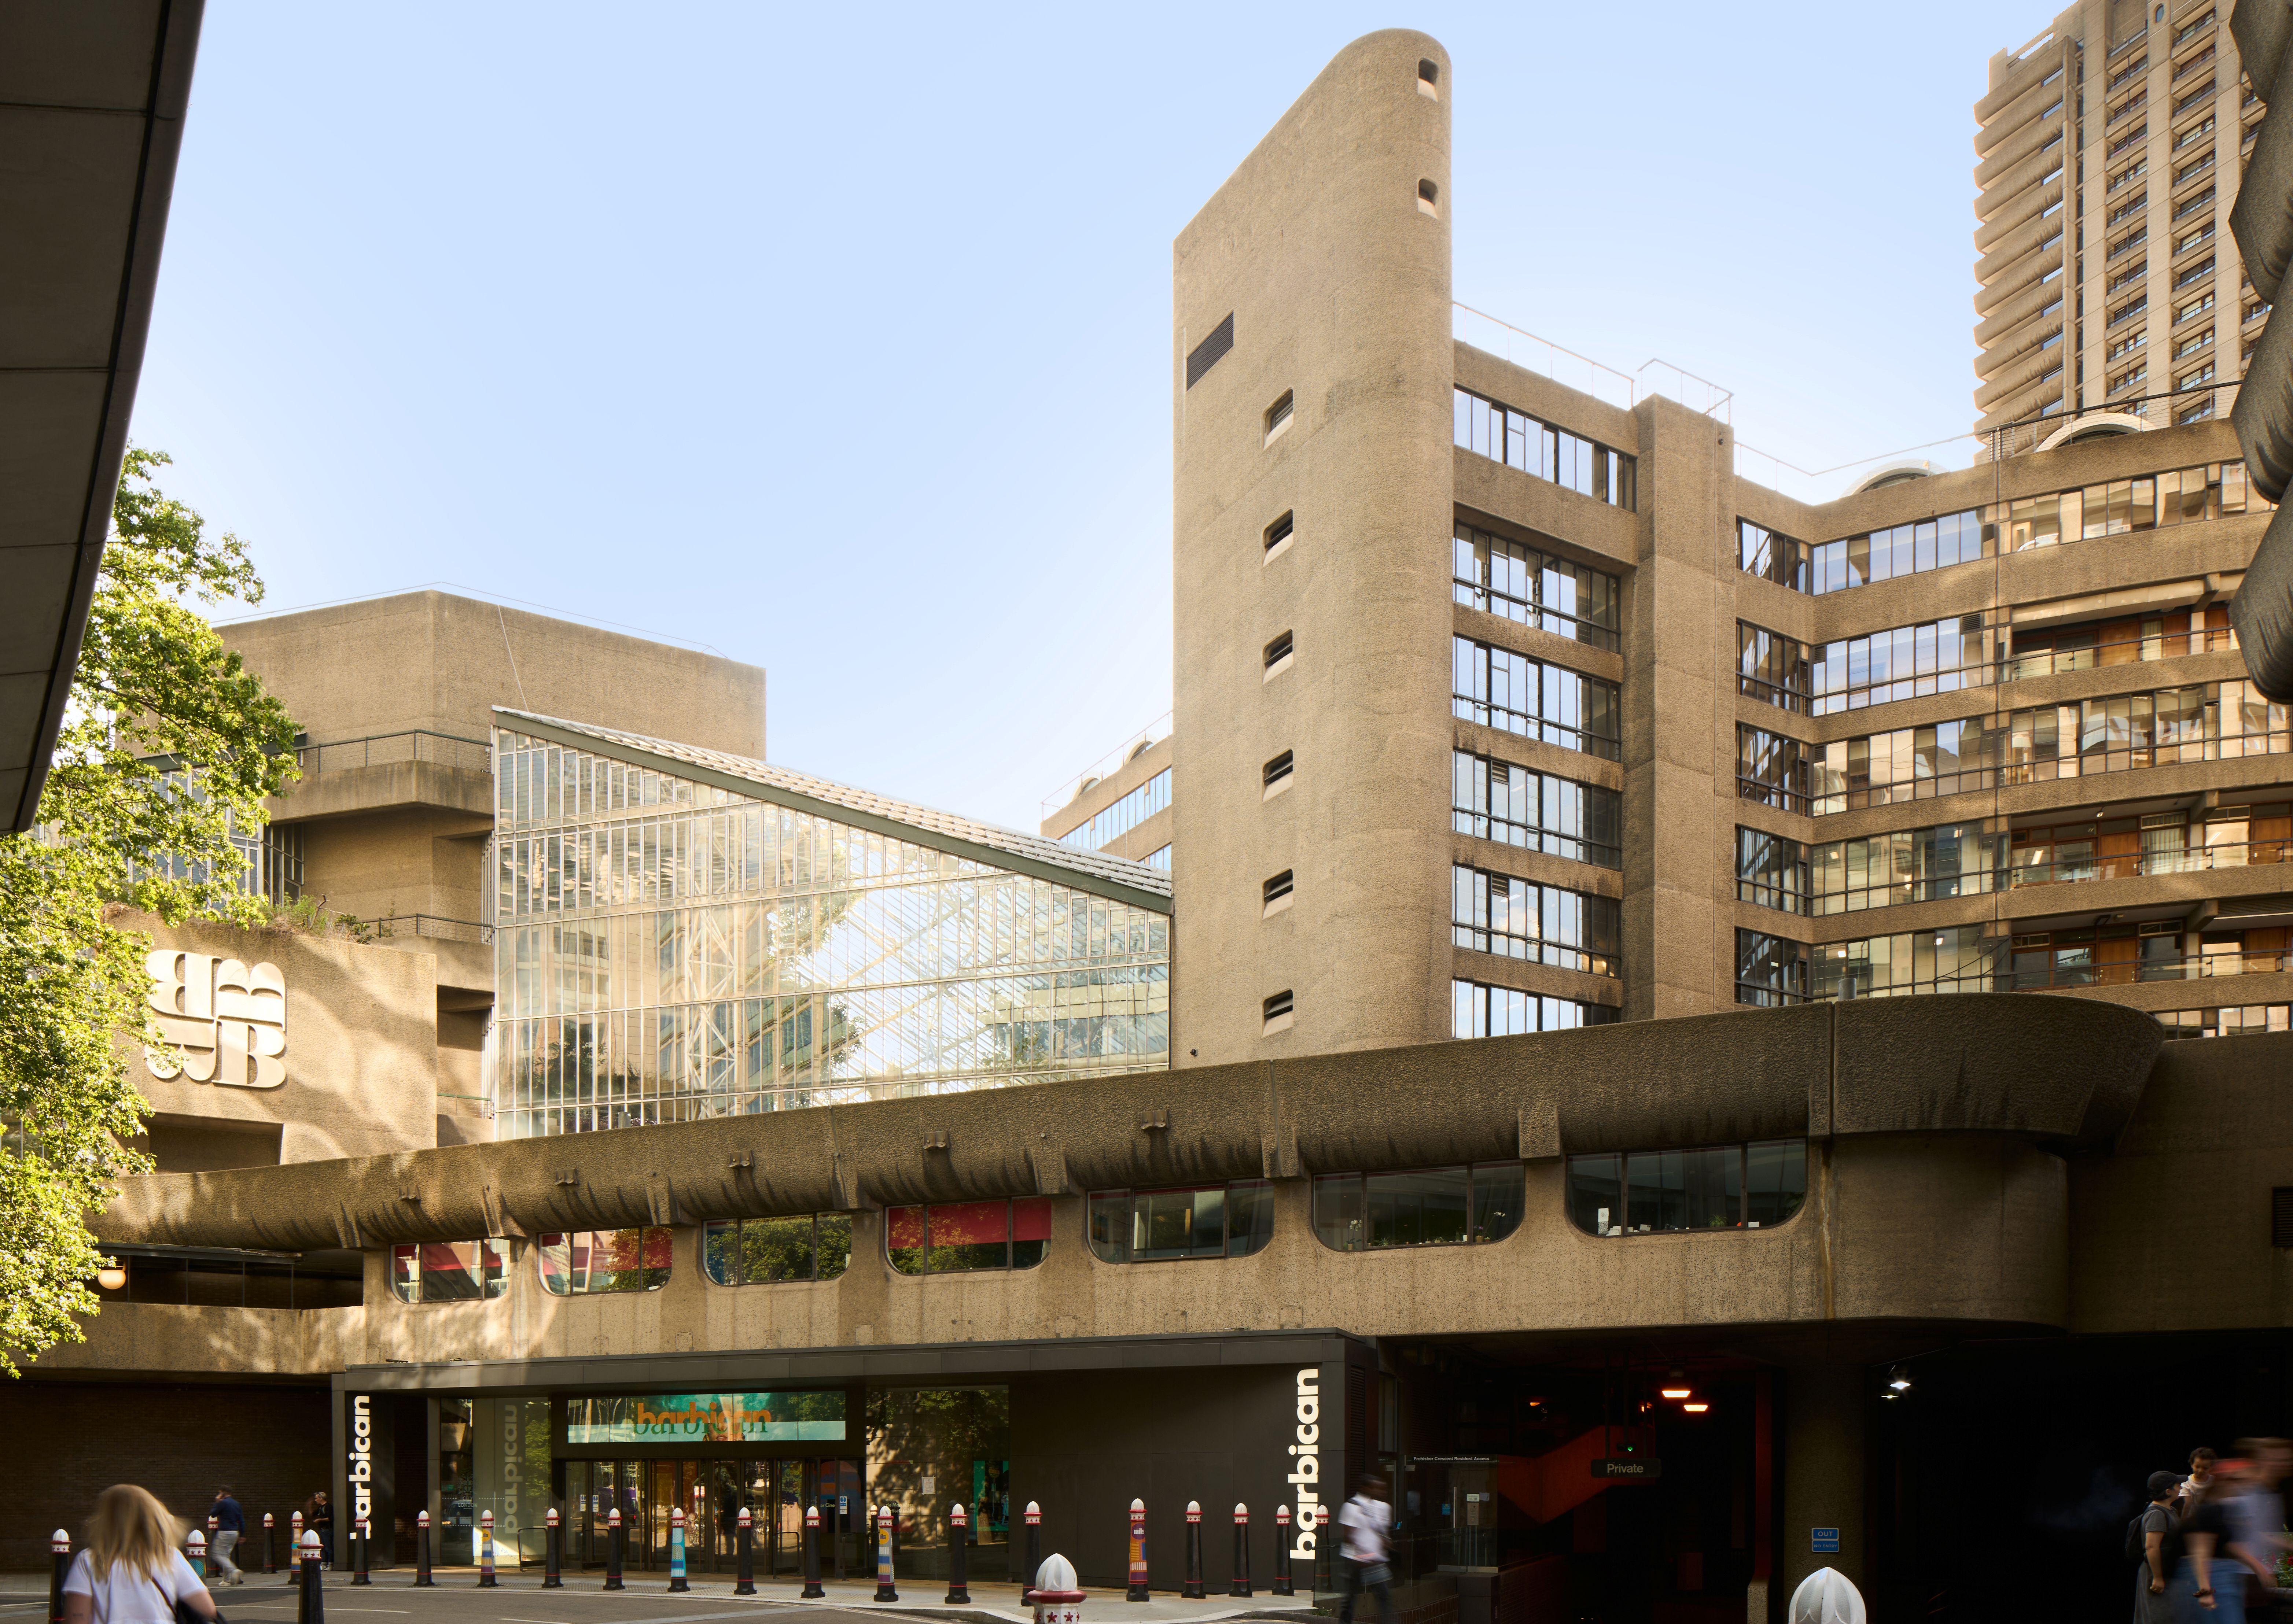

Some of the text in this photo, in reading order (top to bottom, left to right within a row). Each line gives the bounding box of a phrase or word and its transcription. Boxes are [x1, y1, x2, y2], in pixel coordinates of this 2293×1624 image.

[633, 1401, 771, 1435] barbican
[1288, 1368, 1319, 1560] barbican
[1607, 1464, 1644, 1473] Private
